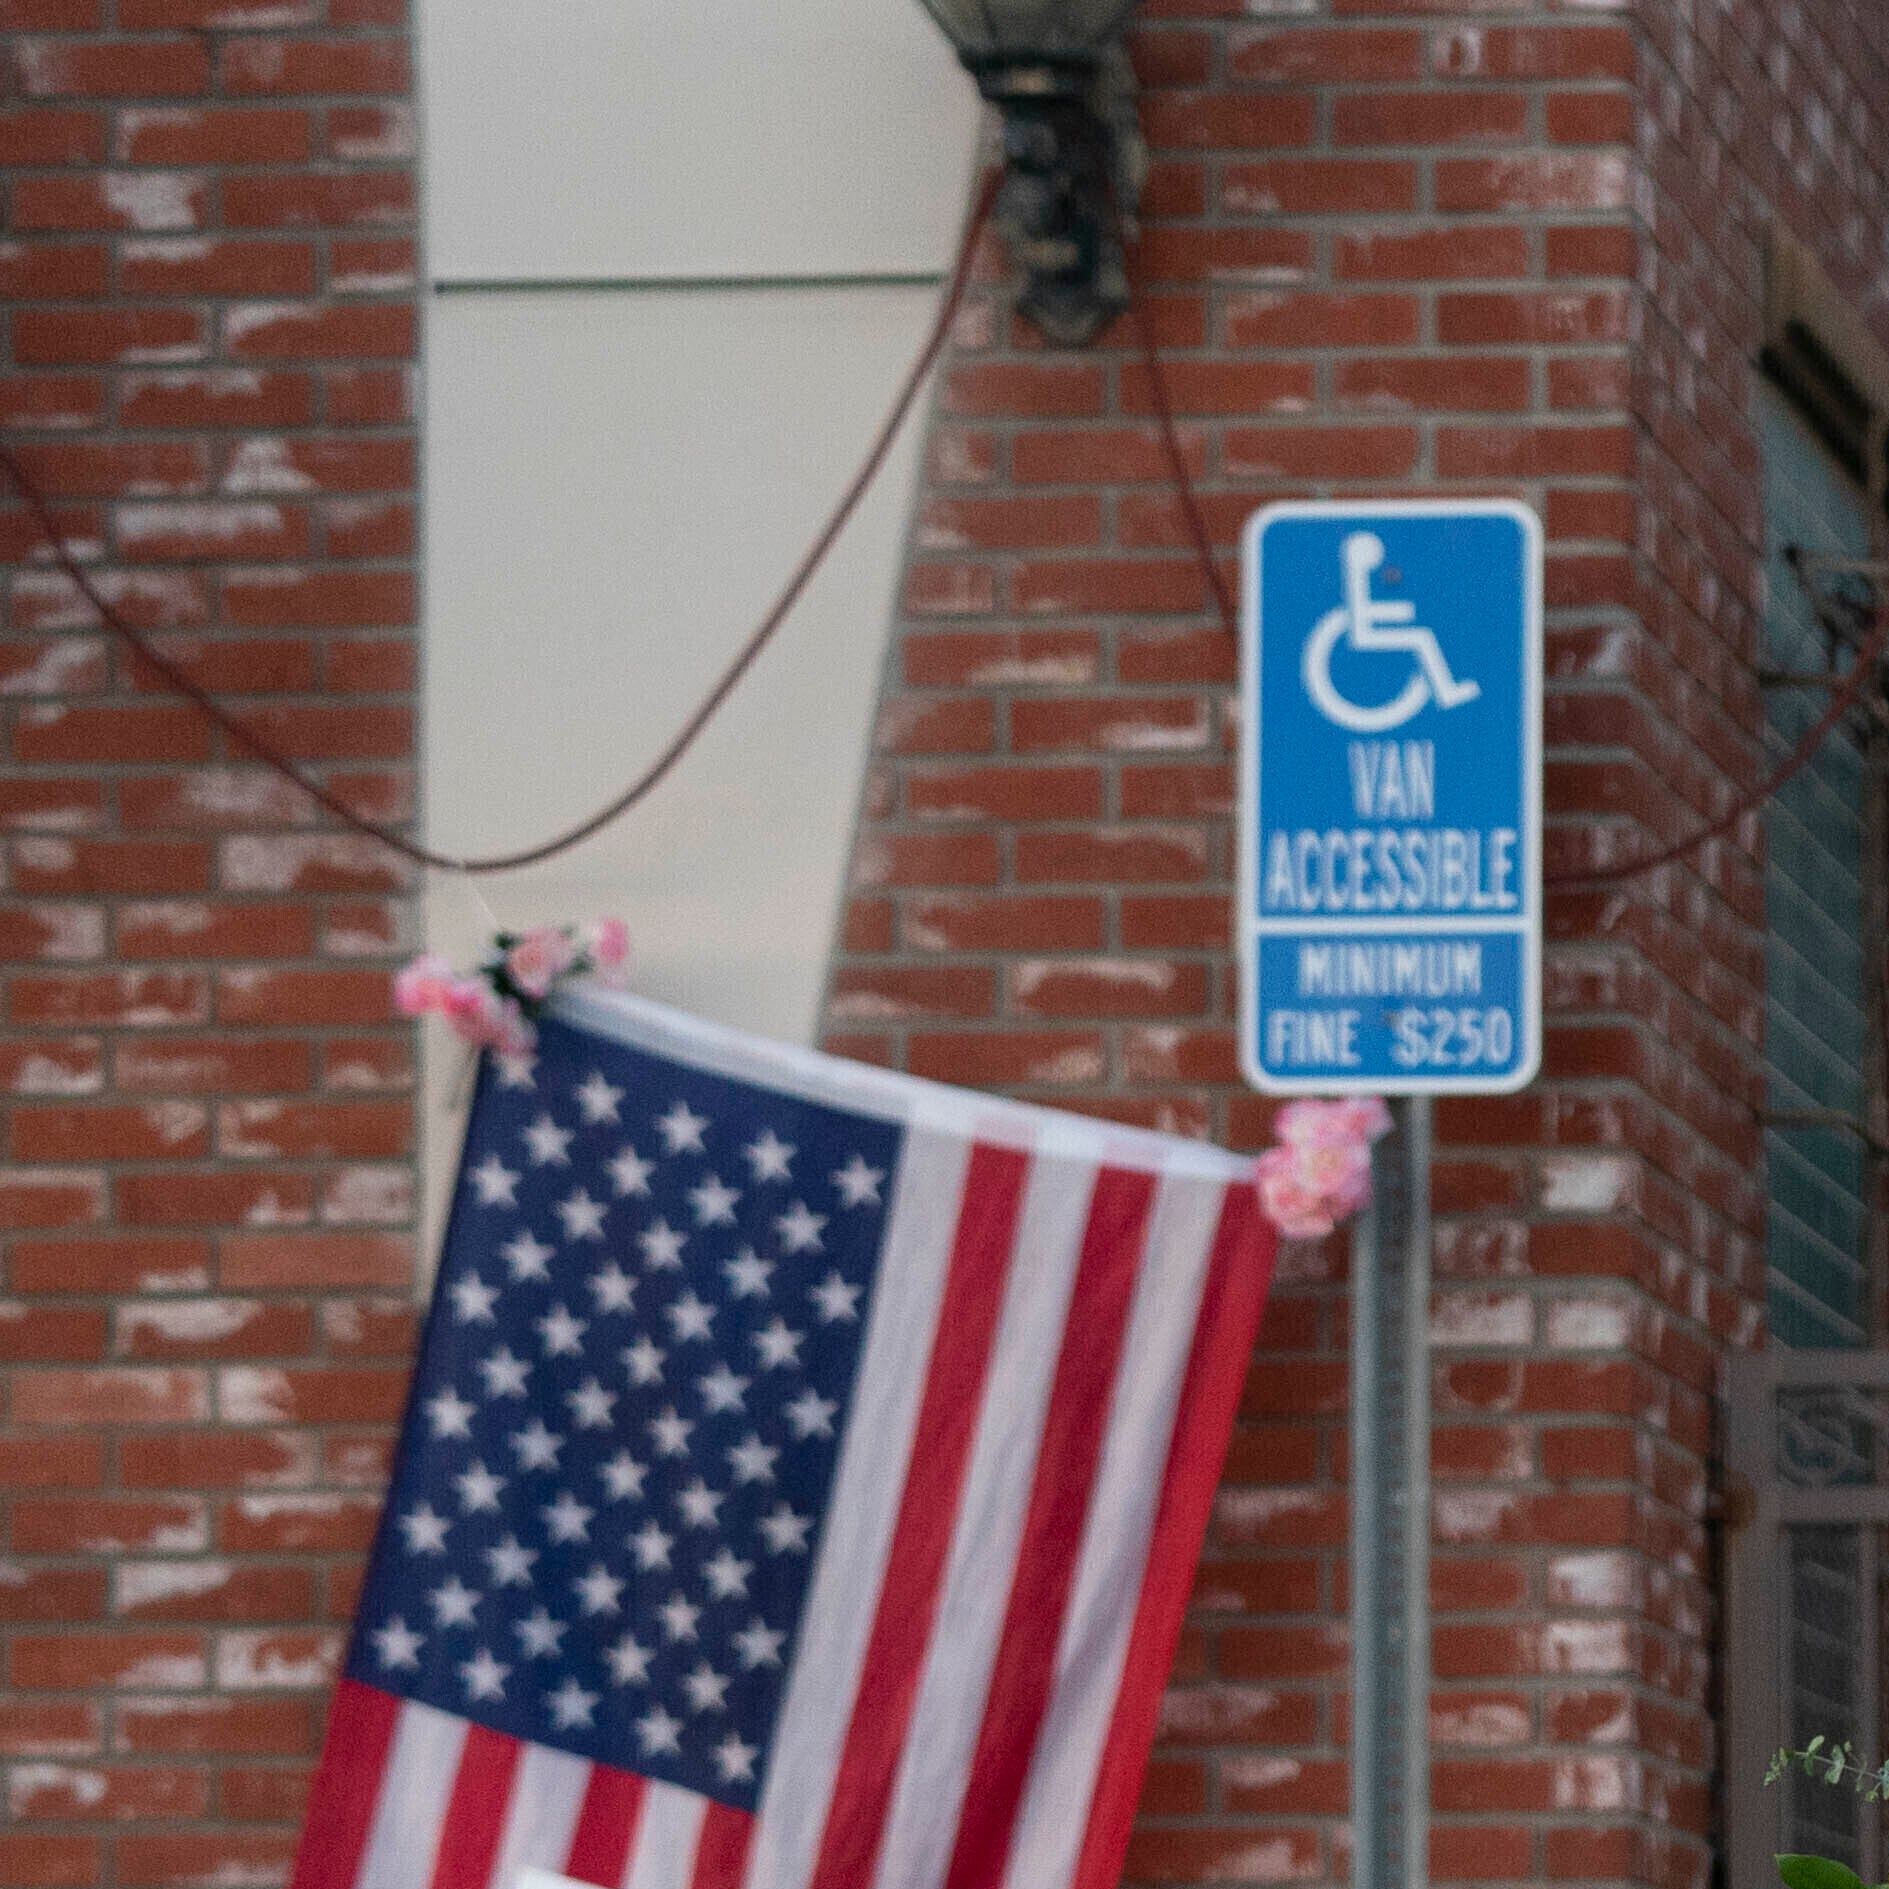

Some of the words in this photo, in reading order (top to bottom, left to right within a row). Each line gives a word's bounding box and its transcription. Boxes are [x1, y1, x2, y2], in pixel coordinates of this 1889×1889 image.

[1348, 741, 1435, 818] VAN
[1266, 828, 1518, 909] ACCESSIBLE
[1303, 943, 1482, 997] MINIMUM
[1267, 1009, 1361, 1066] FINE
[1394, 1007, 1514, 1066] $250
